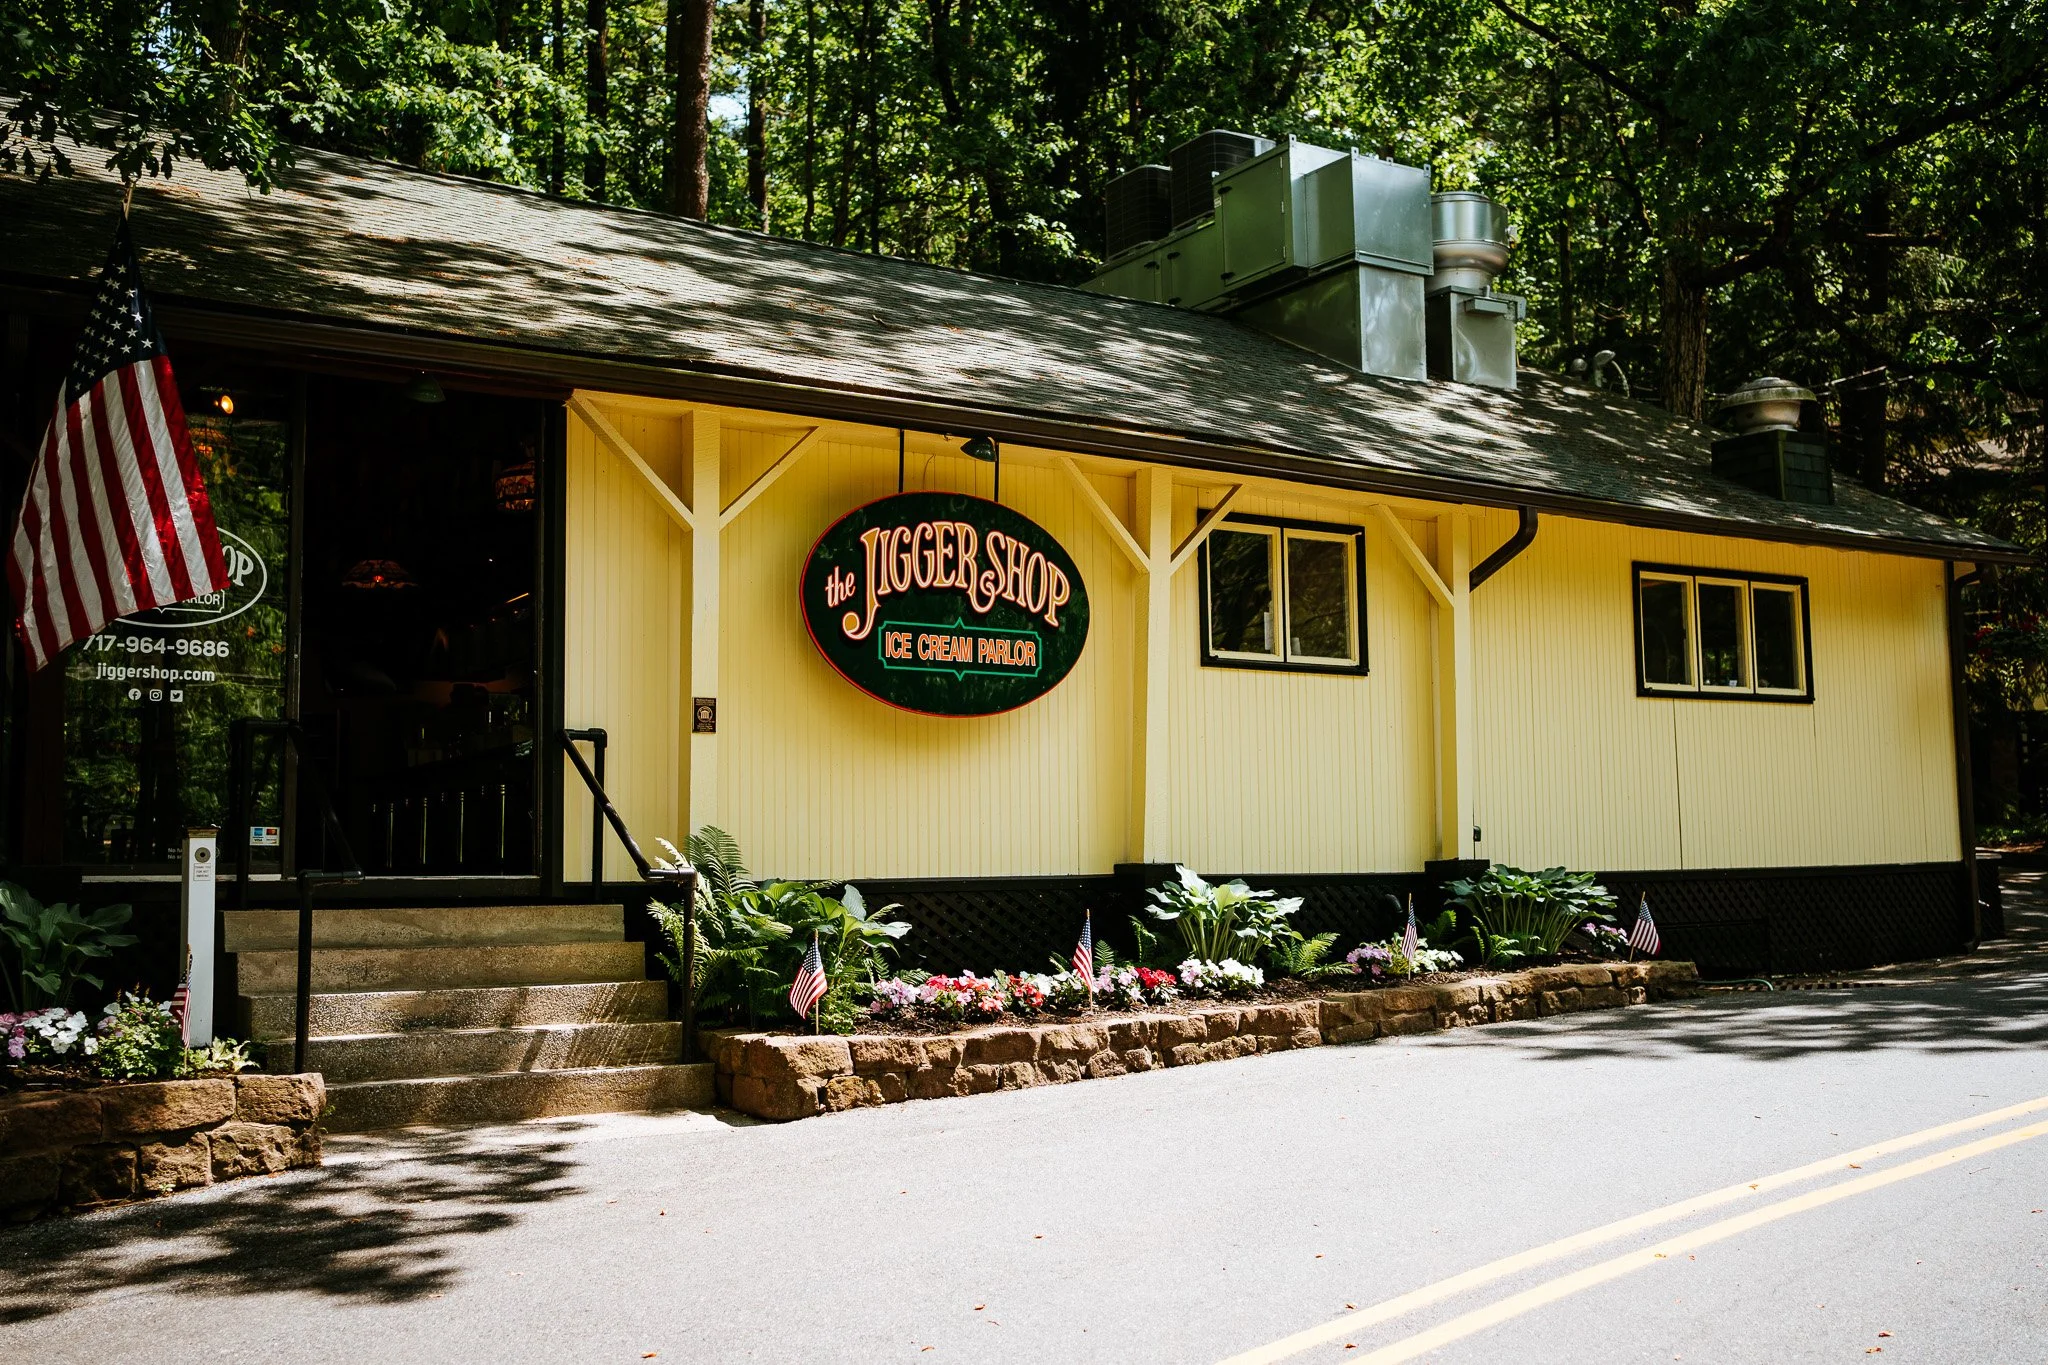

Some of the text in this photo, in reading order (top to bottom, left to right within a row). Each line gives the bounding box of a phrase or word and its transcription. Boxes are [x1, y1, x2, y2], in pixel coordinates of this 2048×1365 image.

[825, 566, 856, 607] the
[842, 521, 1071, 640] JIGGER SHOP
[83, 634, 230, 658] 717-964-9686
[885, 631, 1037, 667] ICE CREAM PARLOR
[96, 663, 216, 683] jiggershop.com
